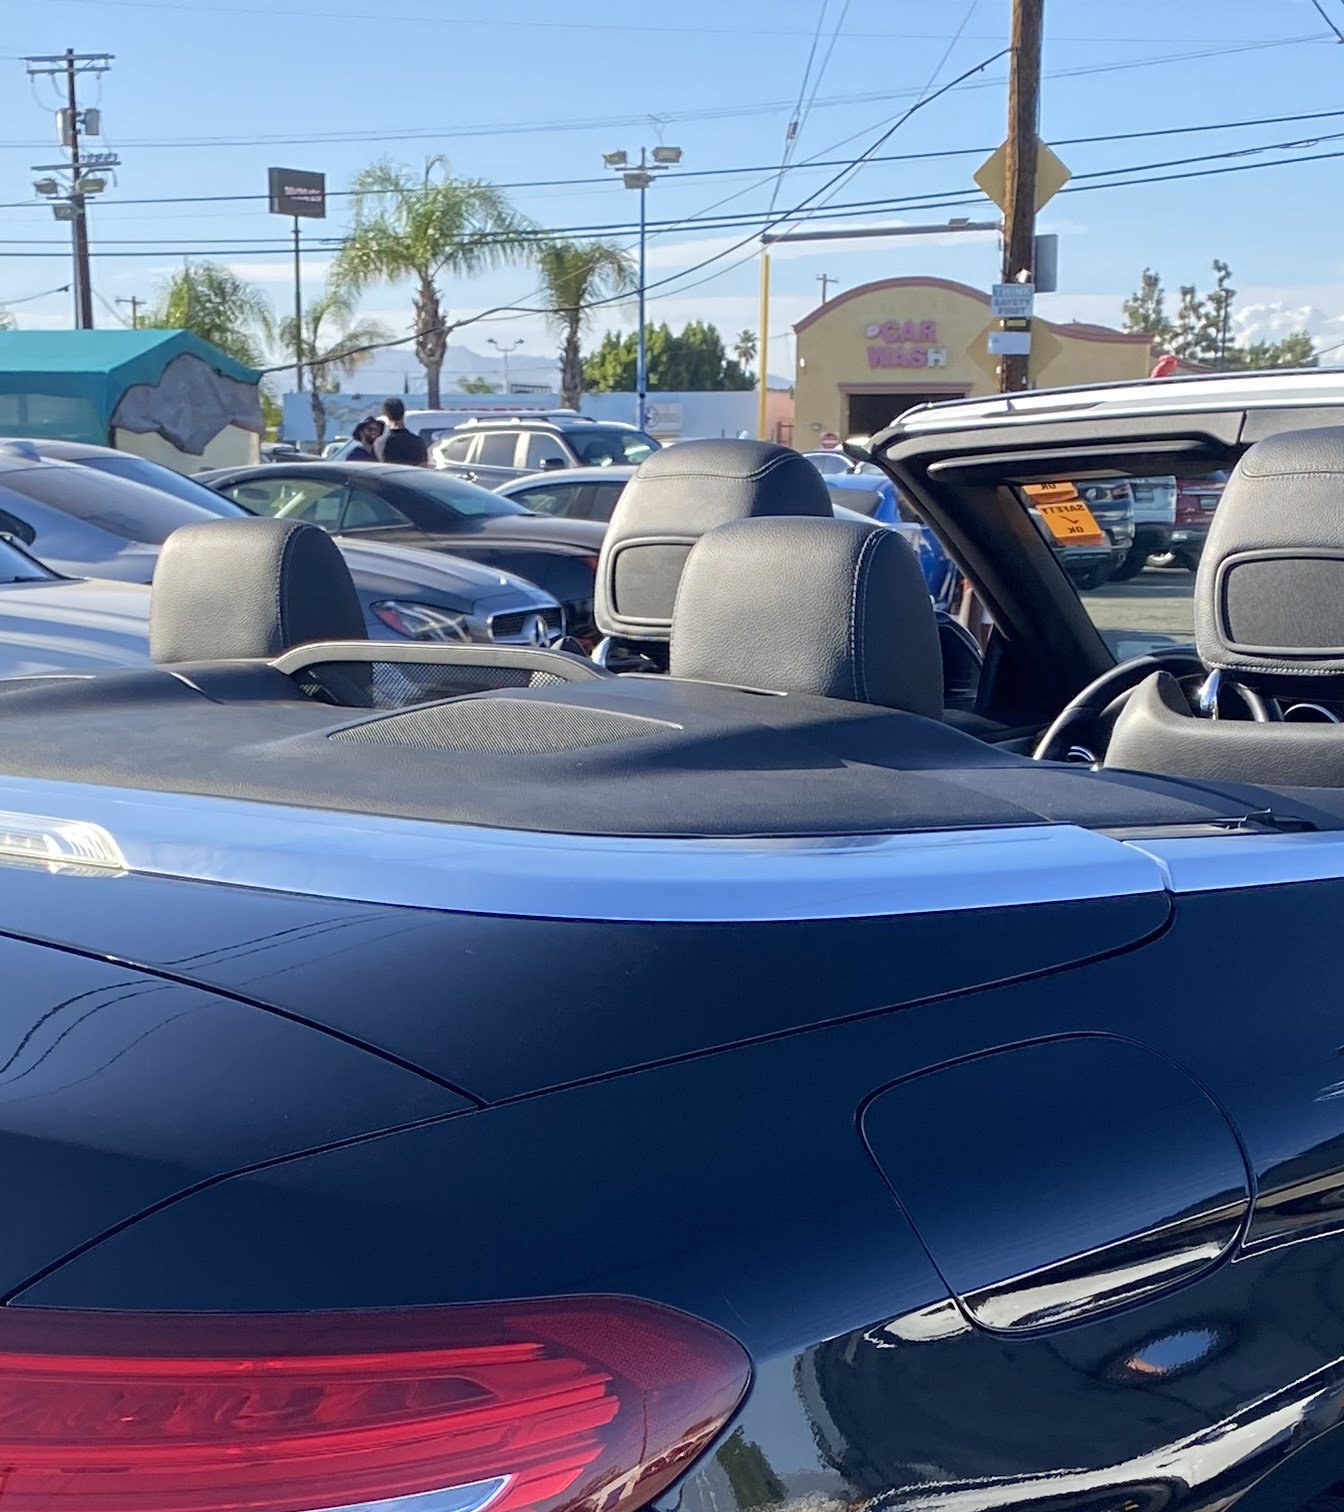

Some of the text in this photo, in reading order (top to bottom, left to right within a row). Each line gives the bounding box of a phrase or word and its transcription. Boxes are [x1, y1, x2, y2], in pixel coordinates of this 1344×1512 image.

[994, 299, 1030, 307] SAFETY
[998, 307, 1026, 315] FIRST
[880, 320, 937, 343] CAR
[867, 347, 947, 369] WASH
